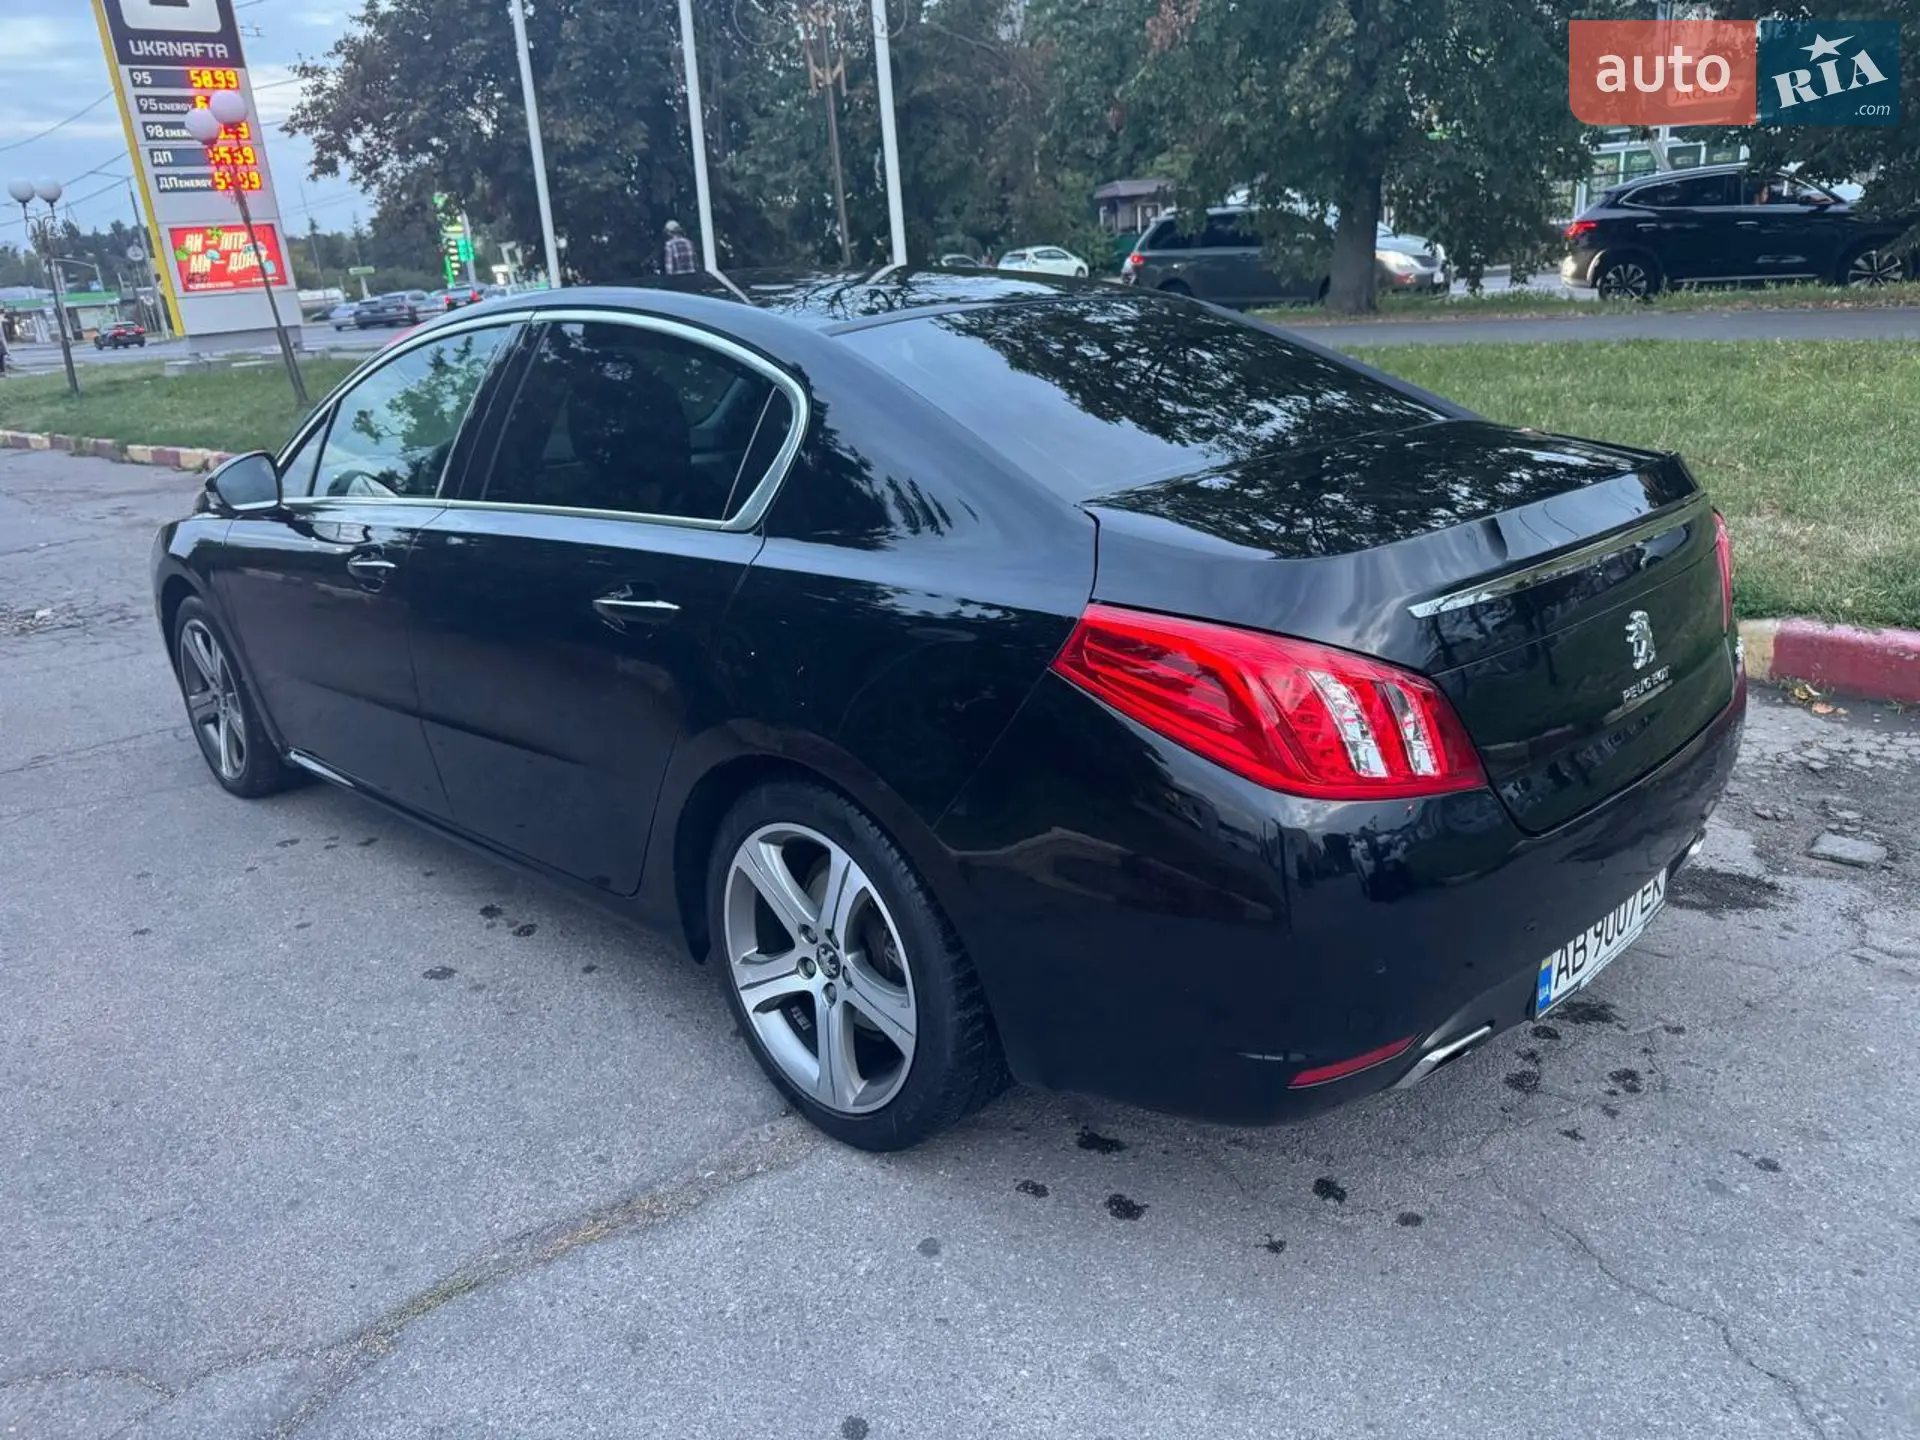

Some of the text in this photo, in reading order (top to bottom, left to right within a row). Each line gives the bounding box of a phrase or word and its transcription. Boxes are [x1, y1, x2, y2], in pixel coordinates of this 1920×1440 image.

[128, 39, 229, 59] UKRNAFTA
[132, 70, 238, 89] 95 58.99
[139, 97, 158, 111] 95
[158, 102, 193, 112] ENERGY
[145, 124, 165, 138] 98
[153, 150, 173, 165] ДП
[1622, 664, 1671, 704] PEUGEOT
[1554, 932, 1587, 989] AB
